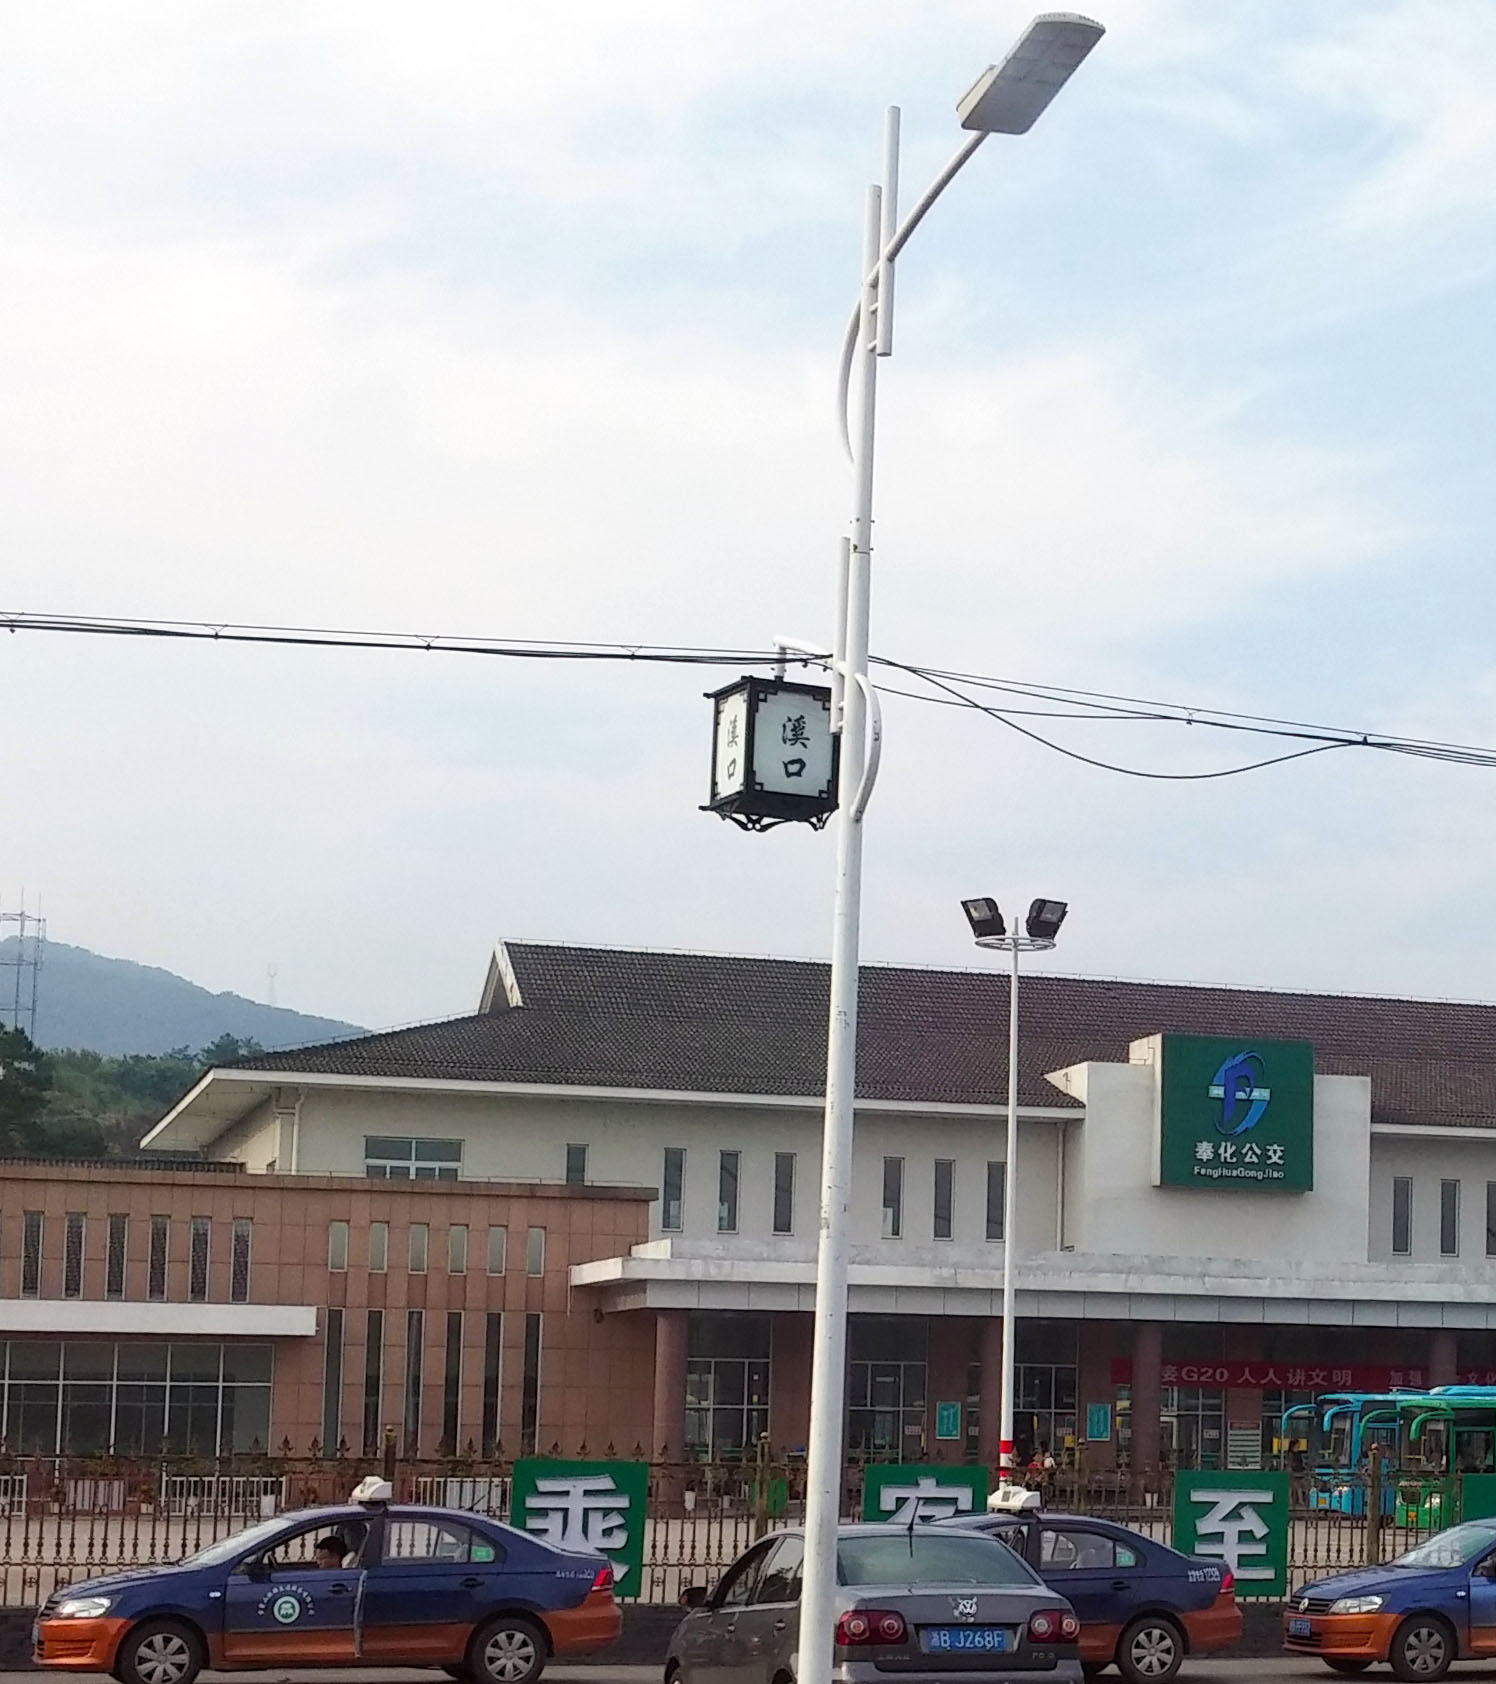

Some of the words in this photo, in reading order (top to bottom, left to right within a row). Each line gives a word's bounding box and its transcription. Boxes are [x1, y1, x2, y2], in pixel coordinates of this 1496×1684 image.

[781, 715, 811, 778] 溪口
[1195, 1141, 1285, 1165] 奉化公交
[1237, 1367, 1353, 1386] 人人讲文明
[525, 1473, 630, 1583] 乘
[1190, 1488, 1276, 1580] 至
